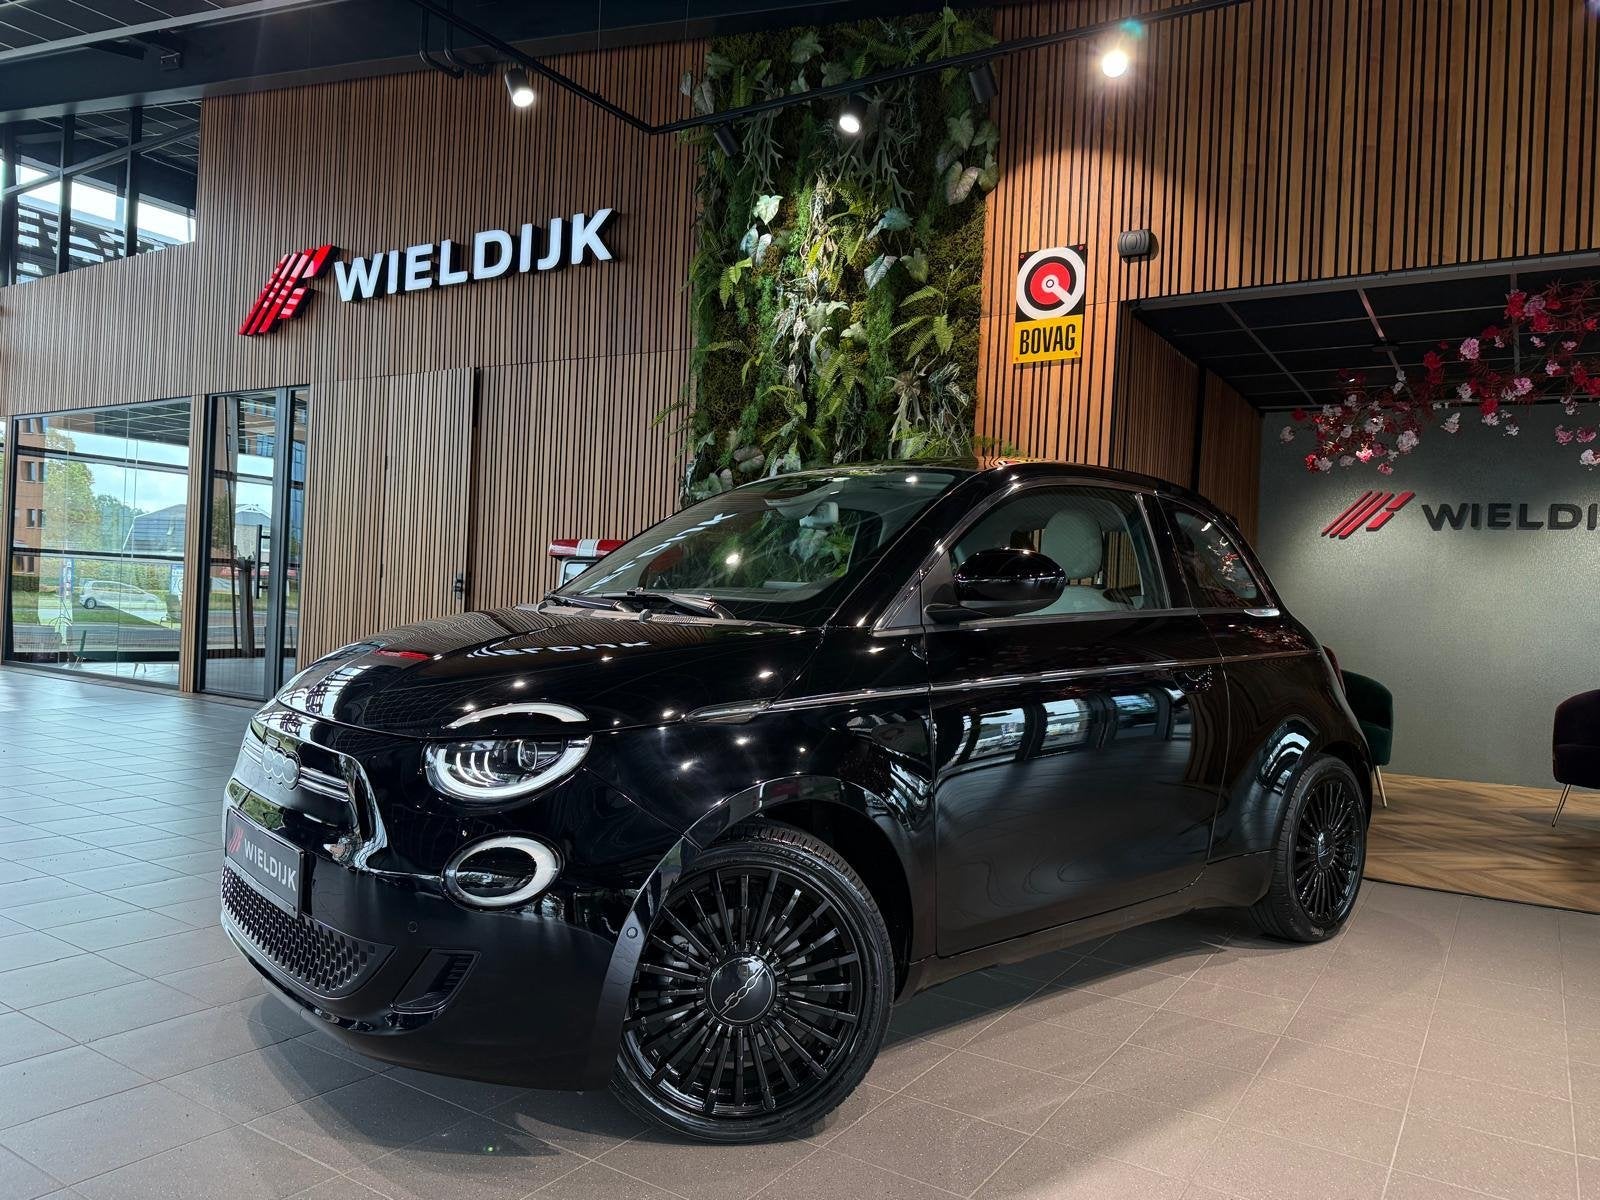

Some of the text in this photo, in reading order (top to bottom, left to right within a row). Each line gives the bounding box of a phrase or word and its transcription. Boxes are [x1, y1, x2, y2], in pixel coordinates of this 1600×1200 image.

[333, 207, 616, 303] WIELDIJK
[1019, 323, 1076, 355] BOVAG
[1421, 502, 1599, 532] WIELDI
[244, 838, 297, 892] WIELDIJK
